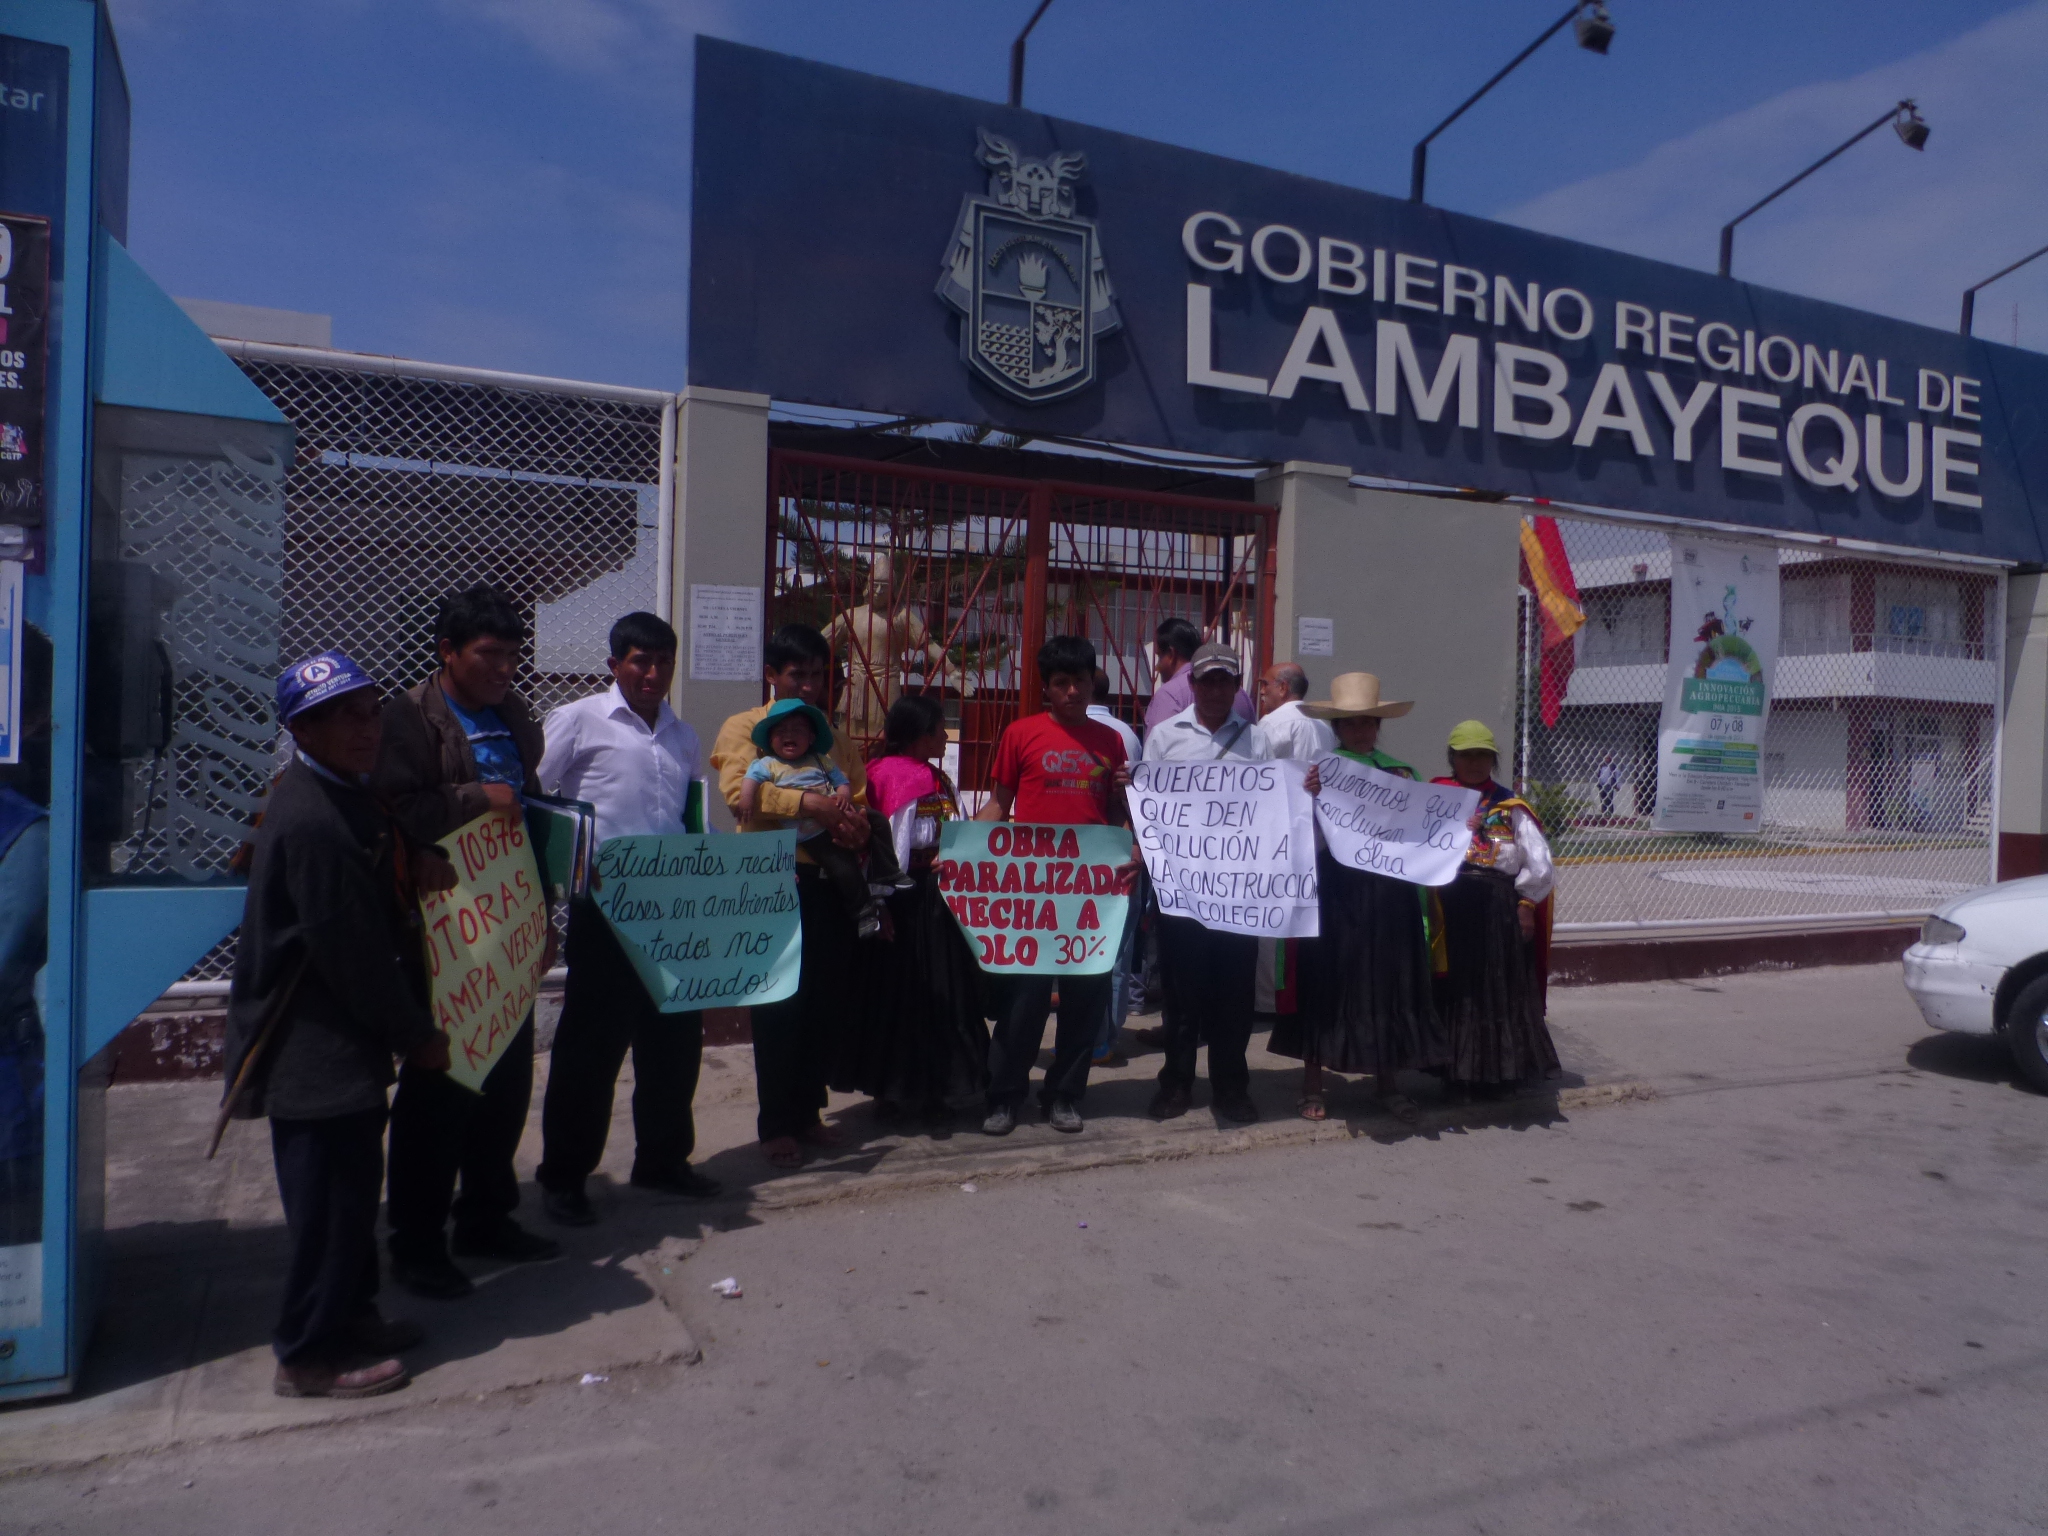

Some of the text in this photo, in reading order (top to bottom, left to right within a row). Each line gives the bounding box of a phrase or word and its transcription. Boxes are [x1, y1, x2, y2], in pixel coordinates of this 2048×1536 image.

[1181, 212, 1593, 340] GOBIERNO
[1616, 301, 1905, 406] REGIONAL
[1919, 368, 1982, 422] DE
[1187, 284, 1983, 508] LAMBAYEQUE
[1690, 691, 1760, 705] AGROPECUARIA
[1710, 718, 1722, 730] 07
[1731, 719, 1744, 732] 08
[1130, 763, 1276, 793] QUEREMOS
[1317, 757, 1462, 829] Queremos que
[1140, 797, 1257, 827] QUE DEN
[457, 816, 524, 882] 10876
[987, 826, 1081, 859] OBRA
[1142, 825, 1289, 861] SOLUCIÓN A
[1415, 820, 1459, 851] la
[597, 840, 729, 879] Estudiantes
[1151, 856, 1174, 883] LA
[670, 897, 696, 920] en
[703, 881, 799, 918] ambientes
[945, 895, 1100, 931] HECHA A
[1197, 901, 1285, 929] COLEGIO
[501, 902, 547, 971] VERDE
[724, 931, 774, 958] no
[1054, 934, 1107, 965] 30%
